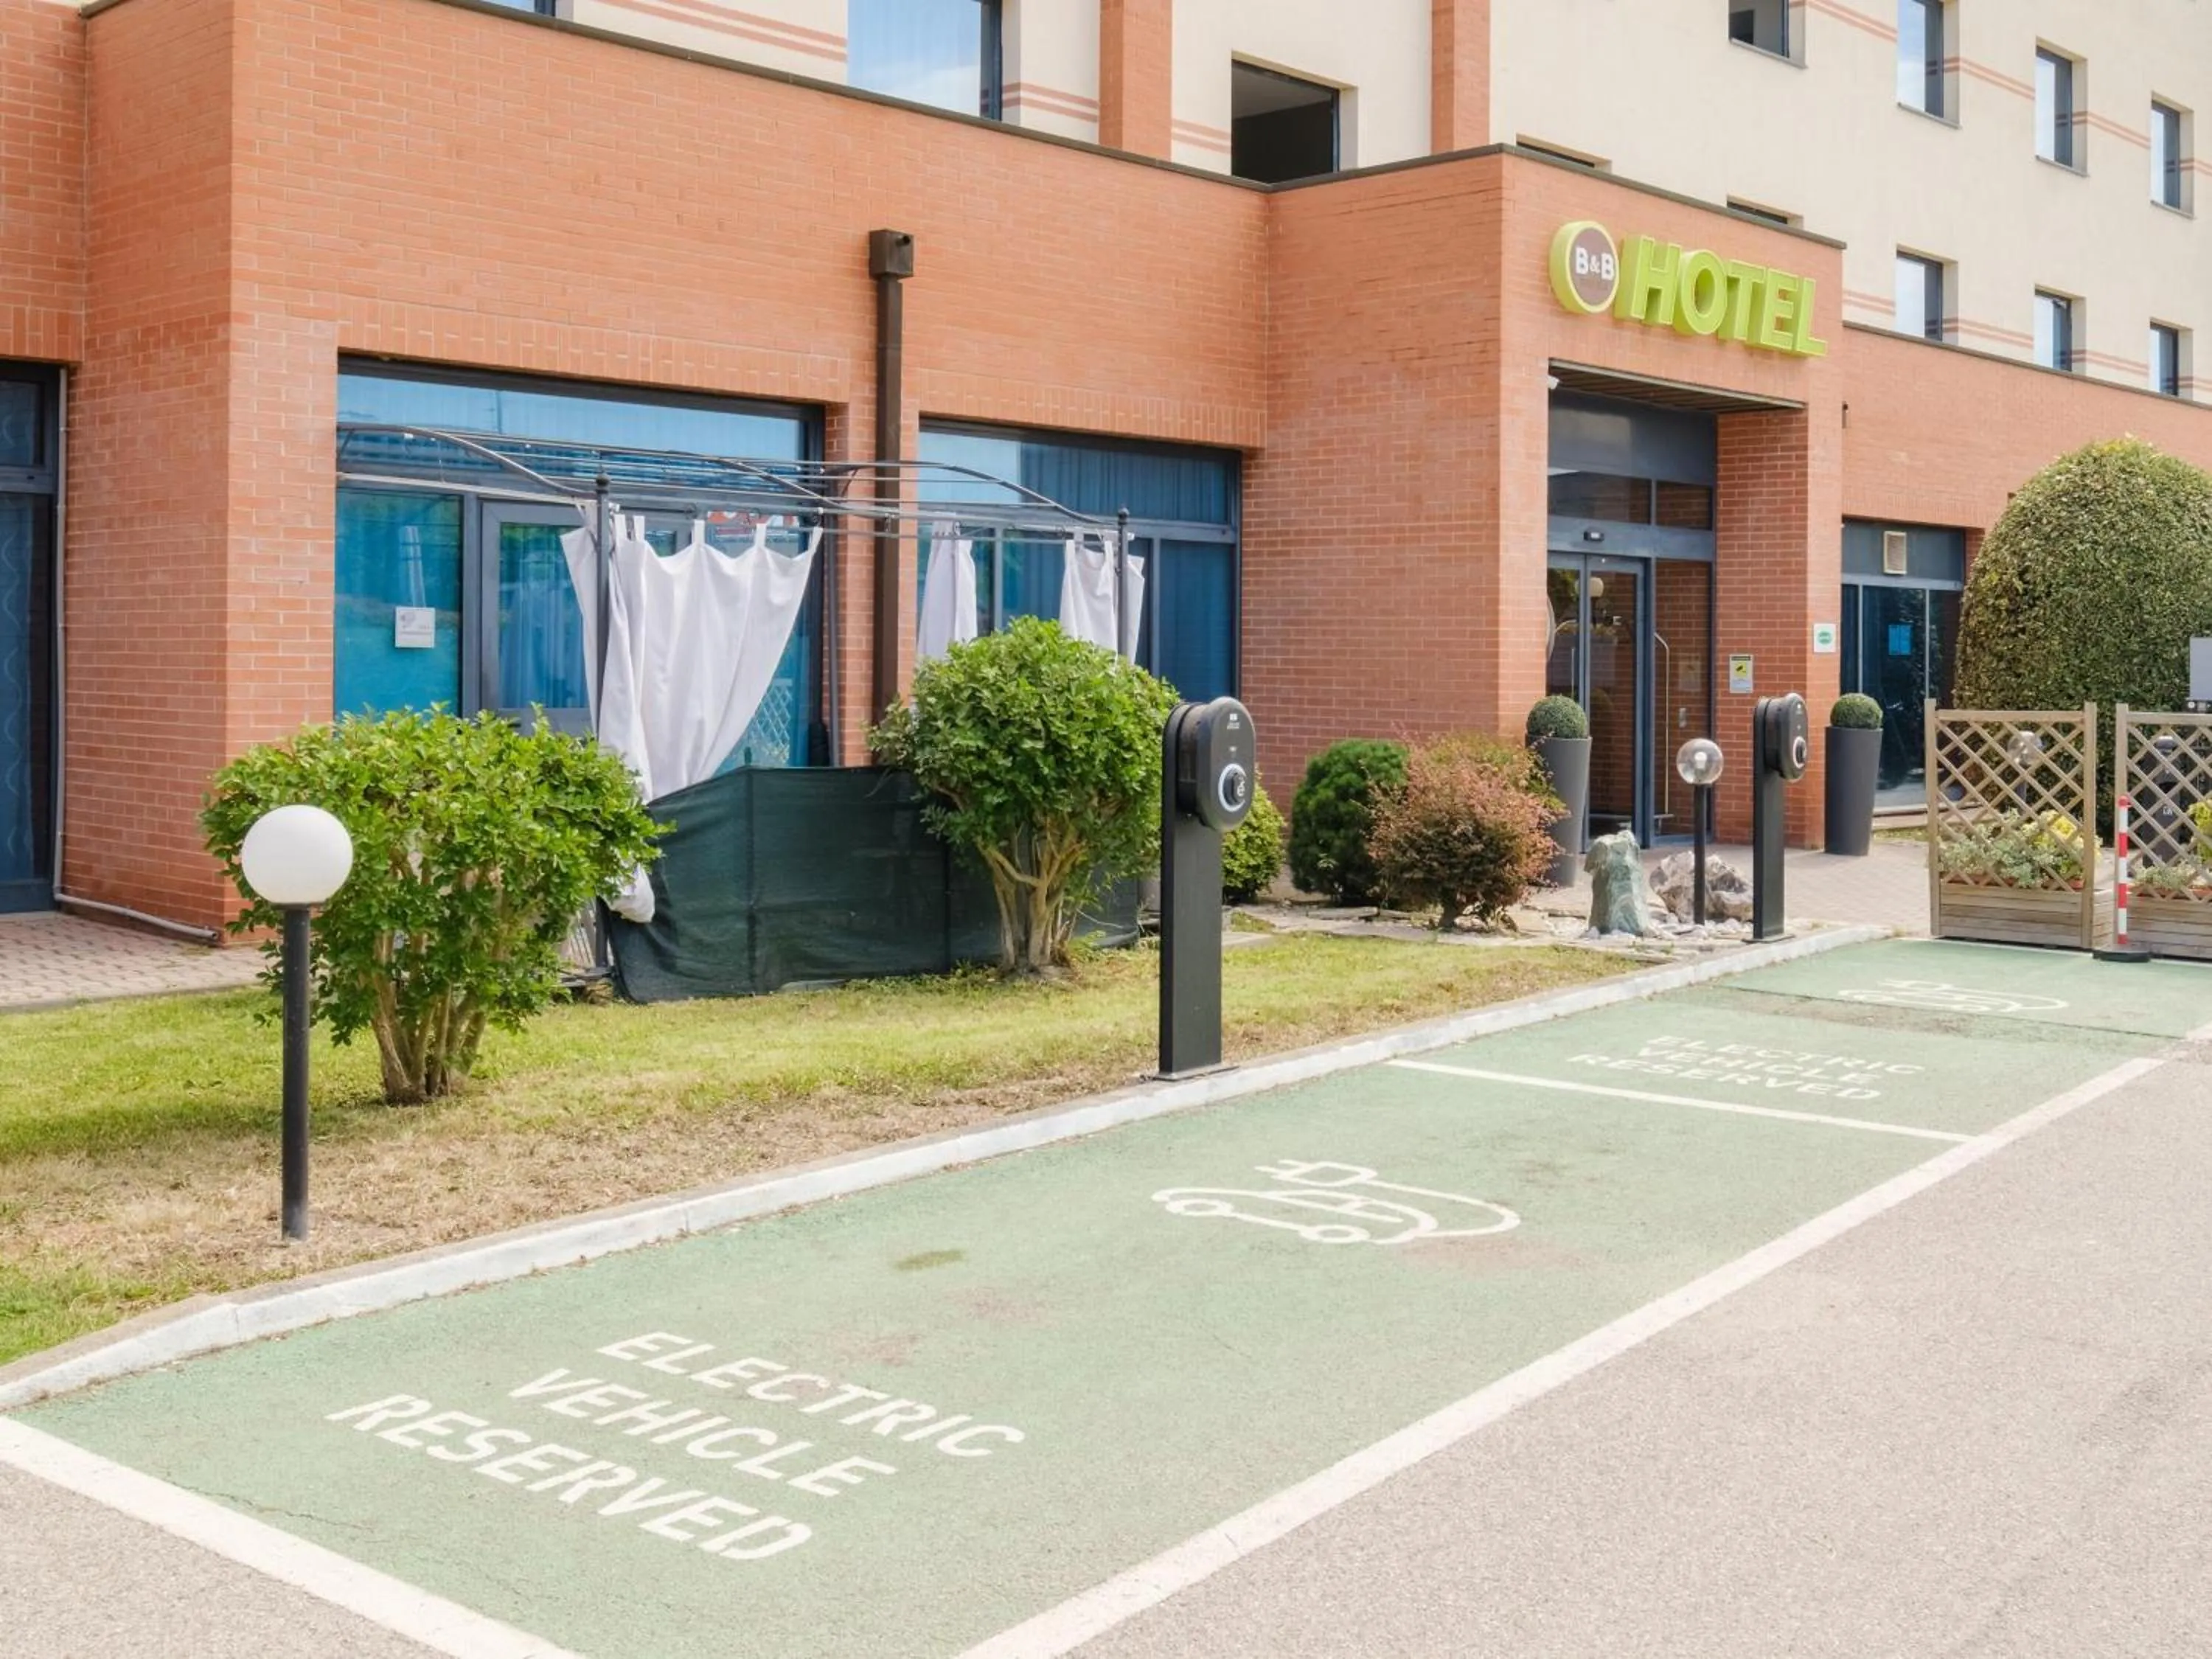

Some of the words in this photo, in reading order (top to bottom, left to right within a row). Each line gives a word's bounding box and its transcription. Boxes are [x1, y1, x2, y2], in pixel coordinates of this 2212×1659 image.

[1576, 247, 1614, 280] B&B
[1618, 235, 1829, 357] HOTEL
[1566, 1054, 1881, 1099] RESERVED
[1638, 1046, 1882, 1085] VEHICLE
[1646, 1035, 1925, 1074] ELECTRIC
[508, 1368, 897, 1497] VEHICLE
[596, 1332, 1025, 1458] ELECTRIC
[324, 1394, 813, 1560] RESERVED
